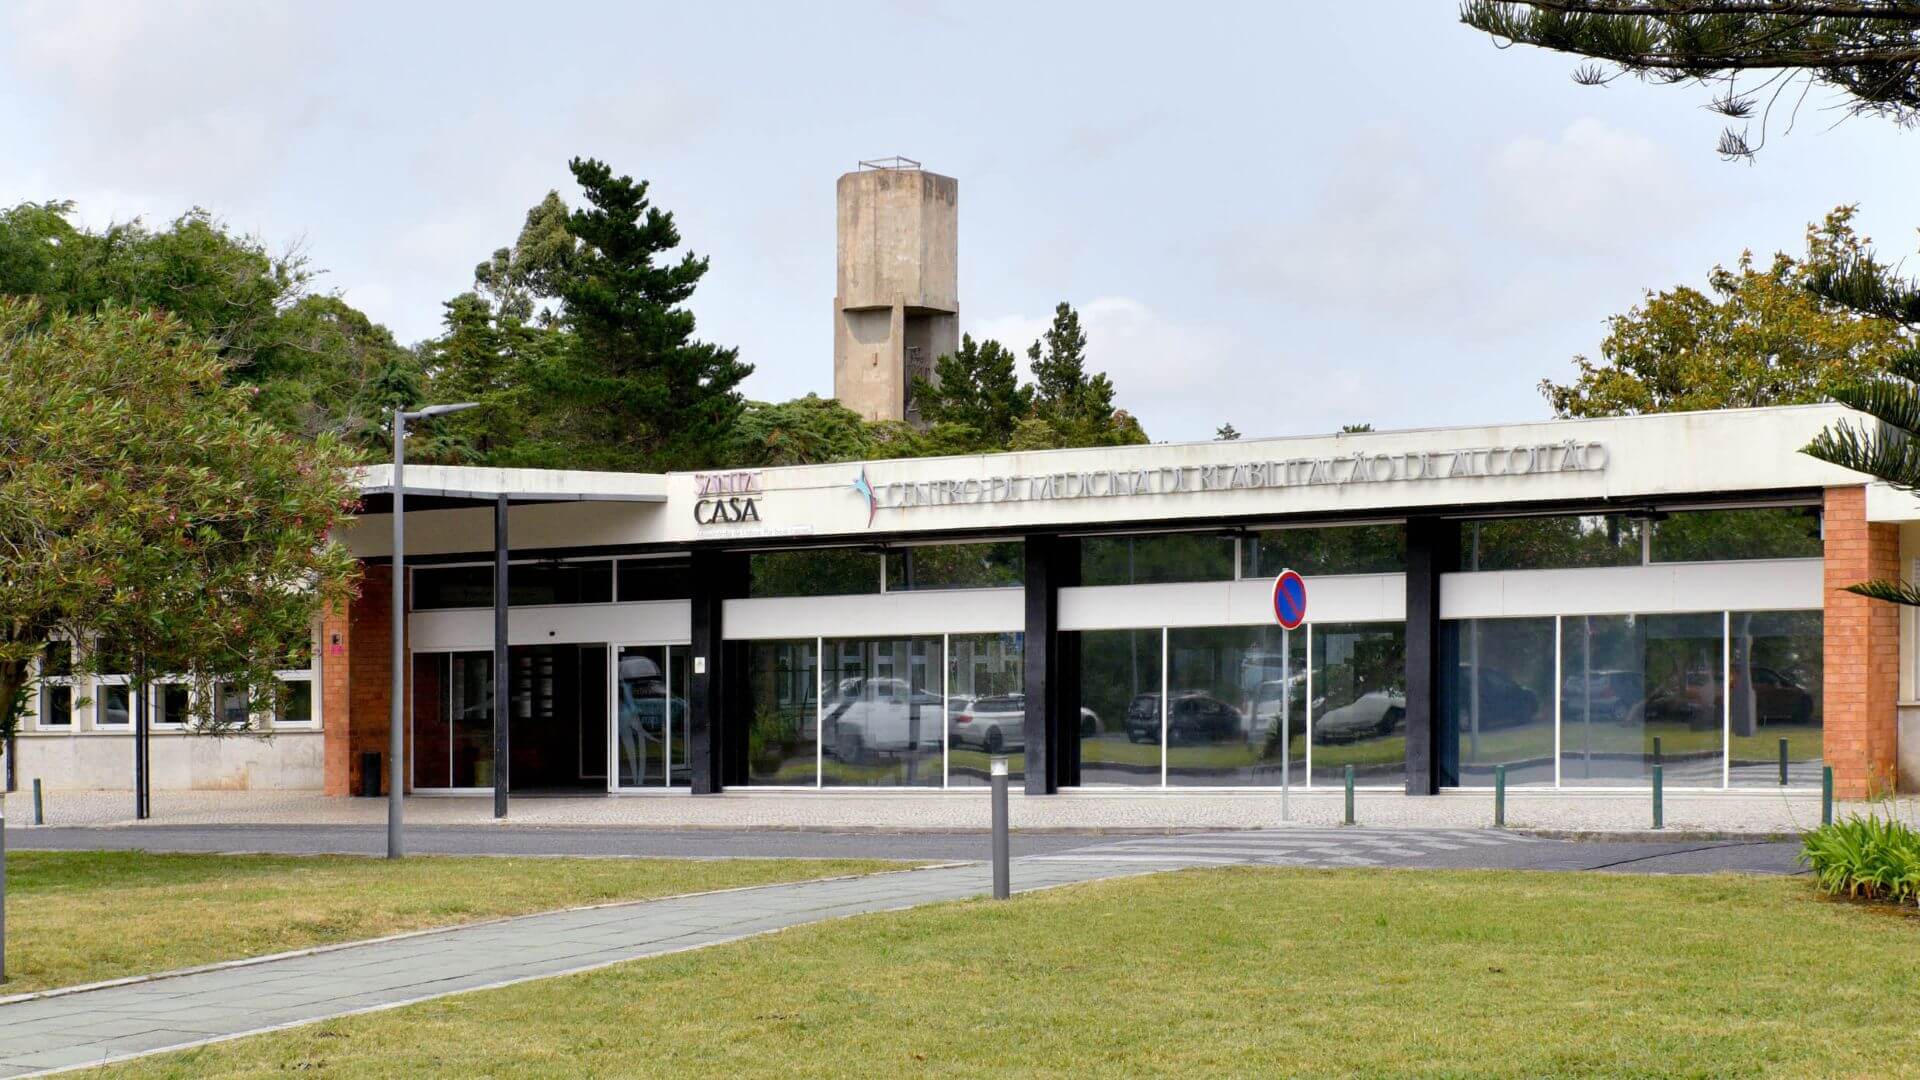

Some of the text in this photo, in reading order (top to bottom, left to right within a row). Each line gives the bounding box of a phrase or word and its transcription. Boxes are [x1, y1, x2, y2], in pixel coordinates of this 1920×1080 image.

[886, 438, 1609, 506] CENTRO DE MEDICINA DE REABILITAÇÃO DE ALCOITÃO
[694, 497, 761, 525] CASA
